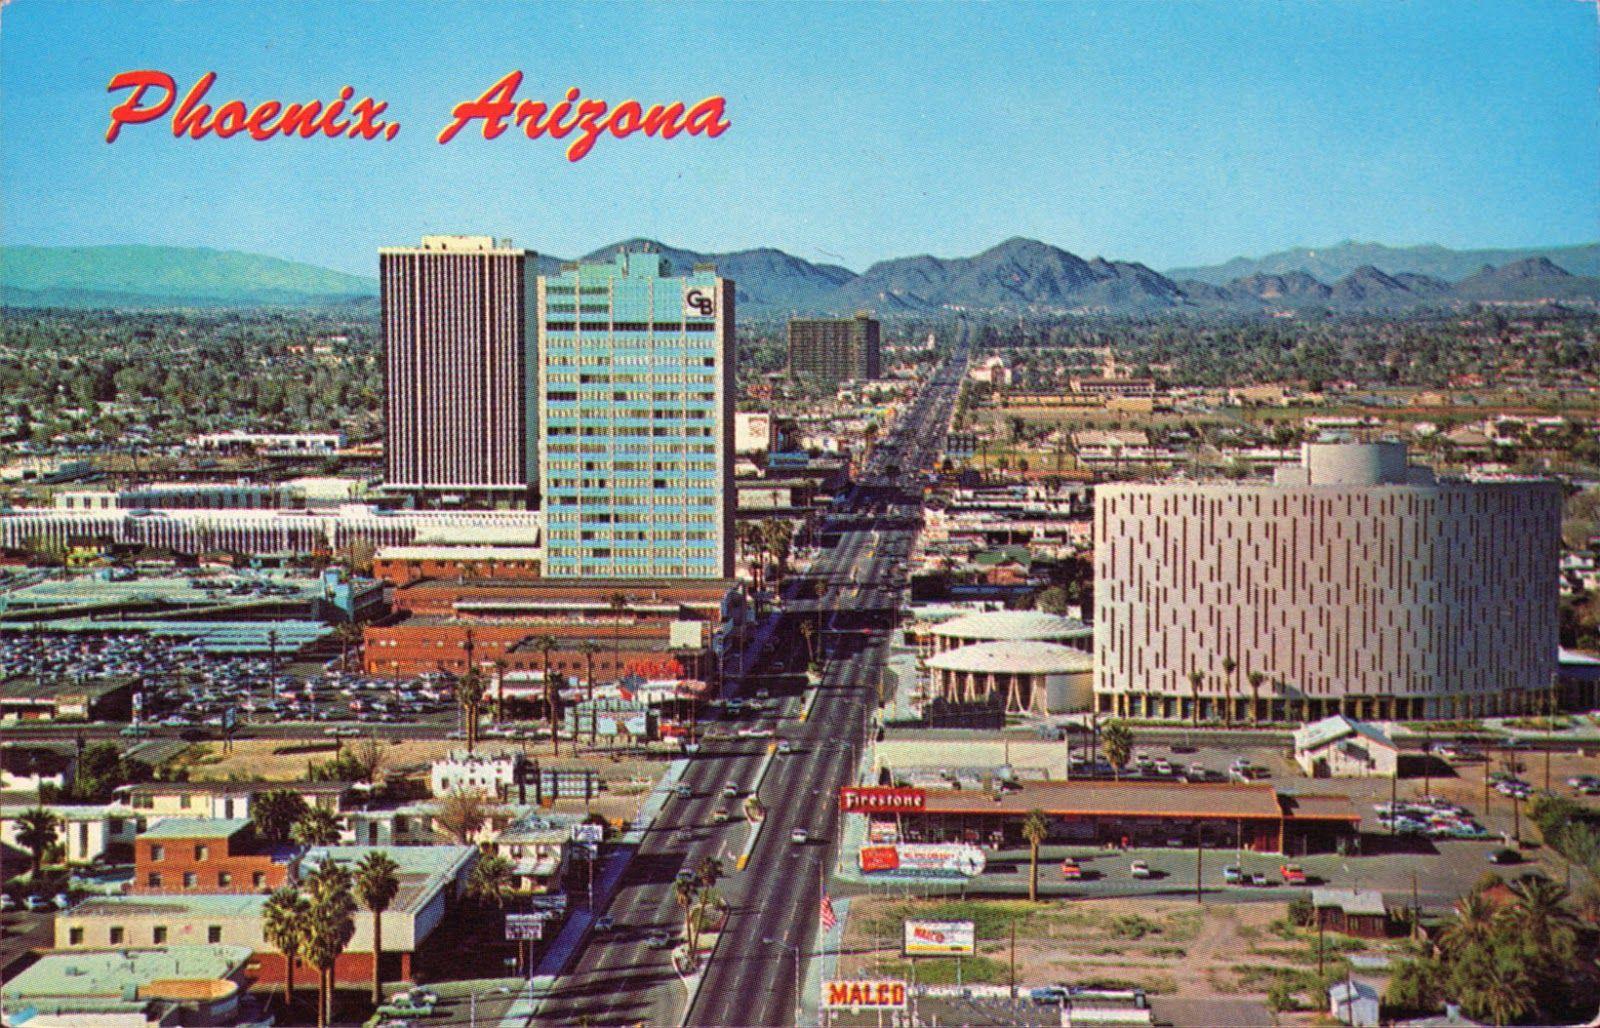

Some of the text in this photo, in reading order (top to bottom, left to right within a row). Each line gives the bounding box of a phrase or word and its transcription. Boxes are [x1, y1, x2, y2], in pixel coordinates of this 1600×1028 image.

[687, 290, 713, 315] GB
[845, 791, 922, 808] Firestone
[828, 982, 905, 1005] MALCO
